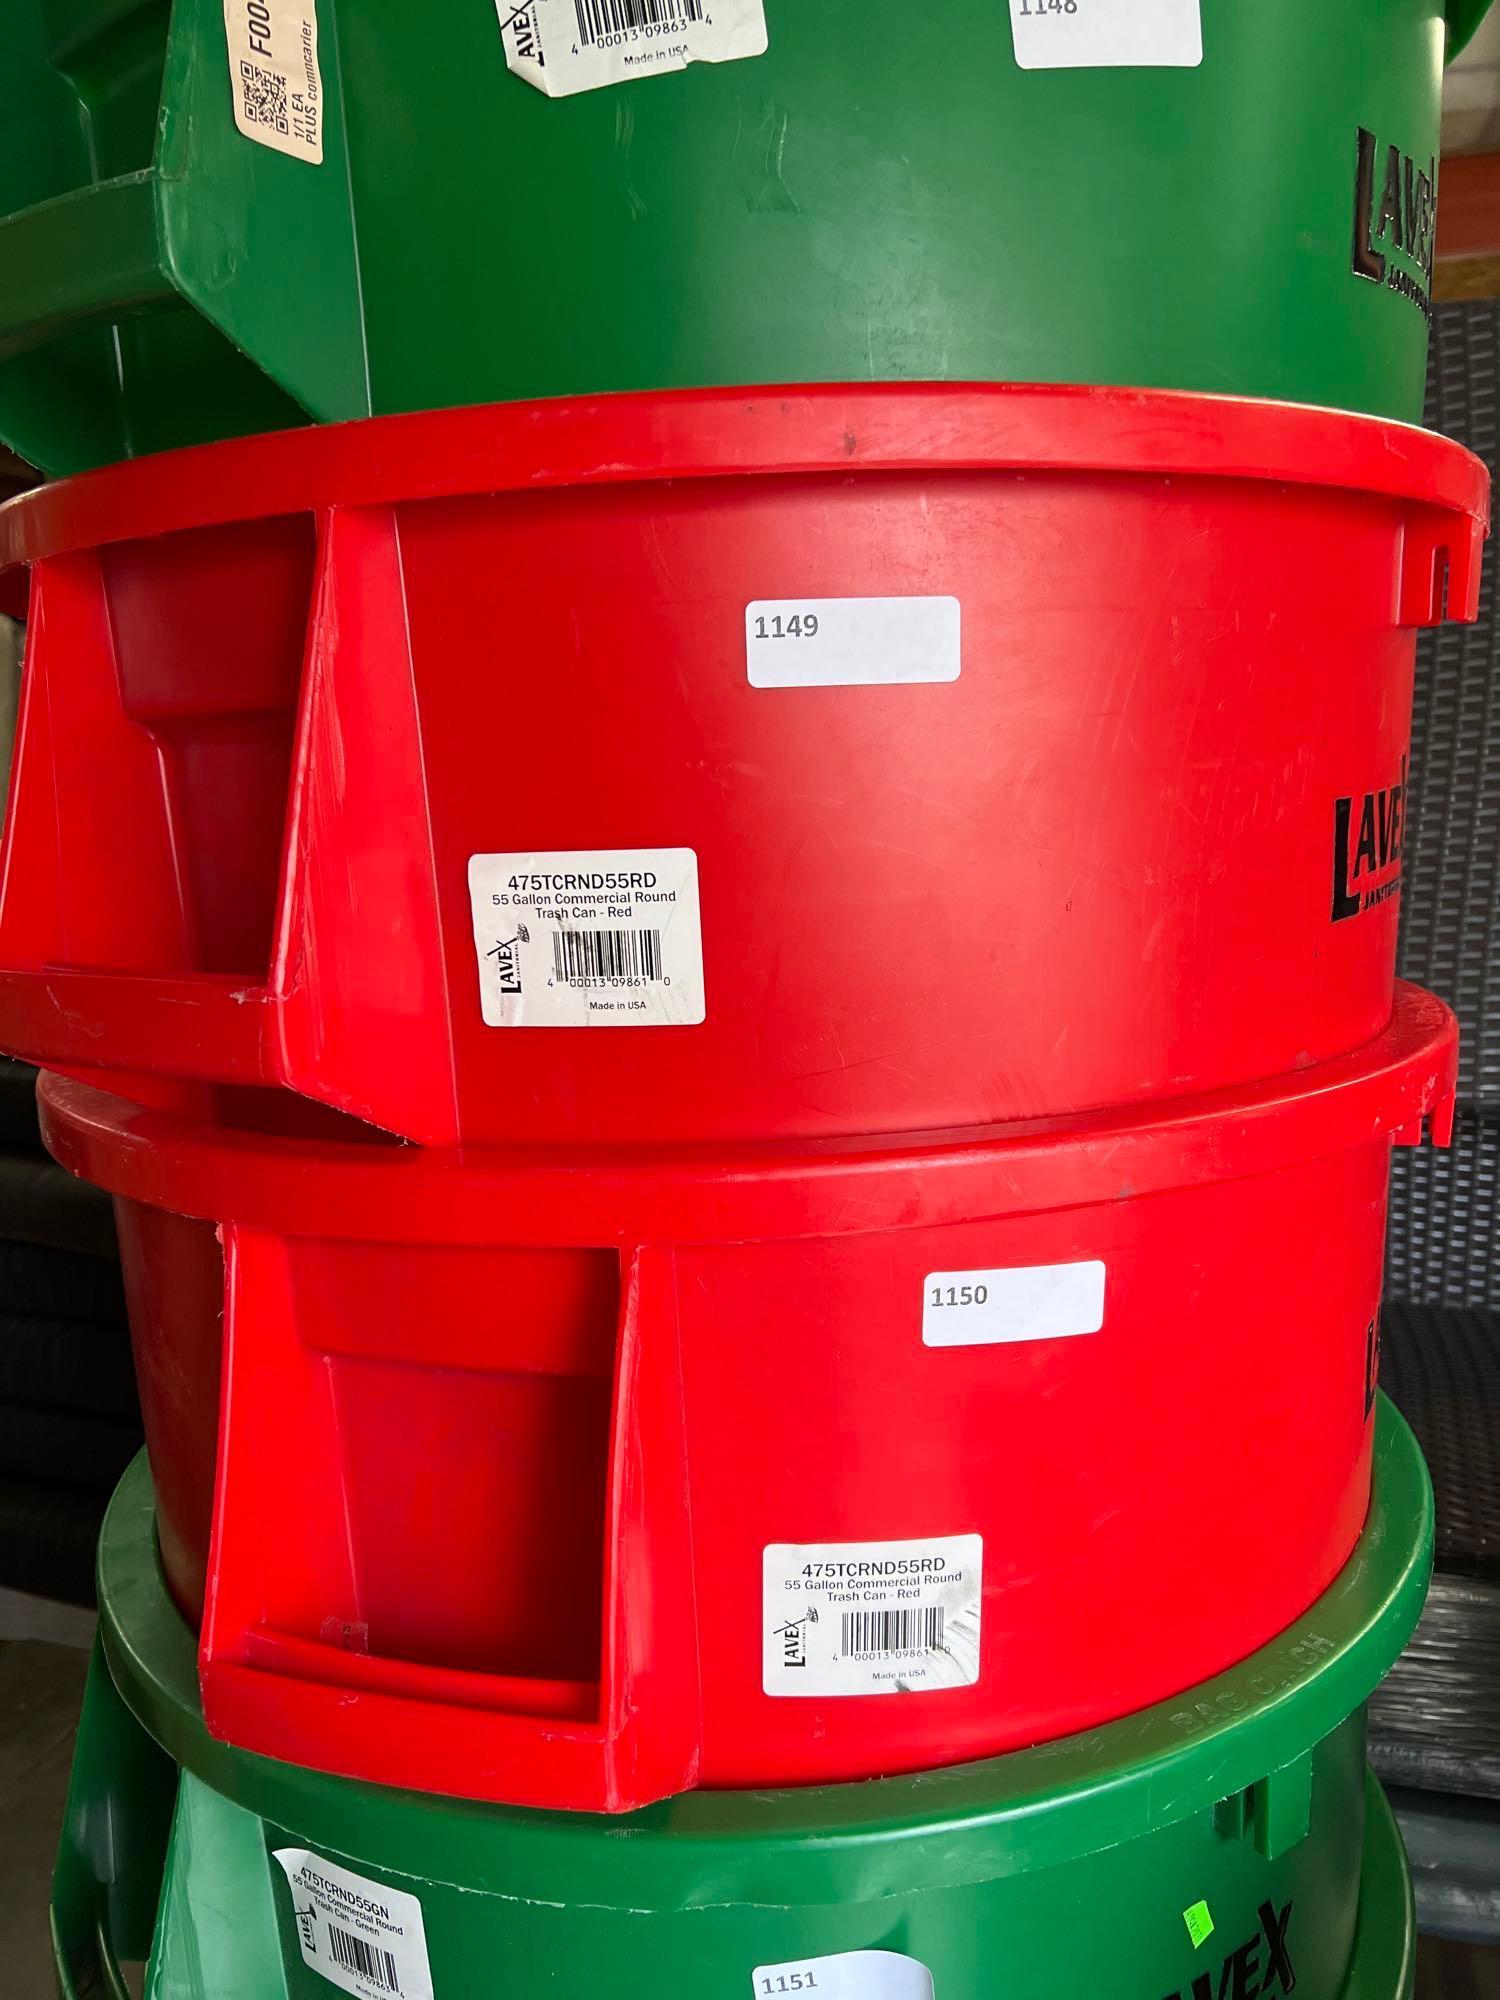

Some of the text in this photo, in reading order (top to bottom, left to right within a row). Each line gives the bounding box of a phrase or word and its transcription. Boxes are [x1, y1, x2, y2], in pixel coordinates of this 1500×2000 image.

[1019, 0, 1078, 15] 1148
[247, 0, 272, 58] F00
[571, 15, 713, 55] 4 00013 09863 4
[624, 53, 654, 67] Made
[656, 50, 666, 60] in
[291, 93, 305, 139] 1/1 EA
[304, 106, 317, 145] PLUS
[755, 614, 819, 639] 1149
[1331, 755, 1406, 923] LAVE
[508, 872, 657, 891] 475TCRND55RD
[492, 890, 676, 905] 55 Gallon Commercial Round
[535, 907, 569, 919] Trash
[572, 907, 596, 918] Can
[608, 906, 633, 918] Red
[487, 935, 522, 994] LAVEX
[547, 976, 671, 988] 4 00013 09861 0
[589, 1000, 647, 1010] Made in USA
[932, 1285, 988, 1307] 1150
[801, 1557, 946, 1578] 475TCRND55RD
[784, 1571, 962, 1590] 55 Gallon Commercial Round
[827, 1591, 860, 1602] Trash
[863, 1590, 886, 1600] Can
[897, 1587, 921, 1599] Red
[773, 1618, 806, 1667] LAVEX
[832, 1653, 838, 1662] 4
[855, 1651, 889, 1661] 00013
[895, 1649, 929, 1659] 09861
[872, 1669, 926, 1680] Made in USA
[300, 1866, 389, 1920] 475TCRND55GN
[292, 1874, 404, 1936] 55 Gallon Commercial Round
[314, 1896, 334, 1915] Trash
[335, 1909, 350, 1923] Can
[355, 1919, 380, 1936] Green
[762, 1971, 818, 1994] 1151
